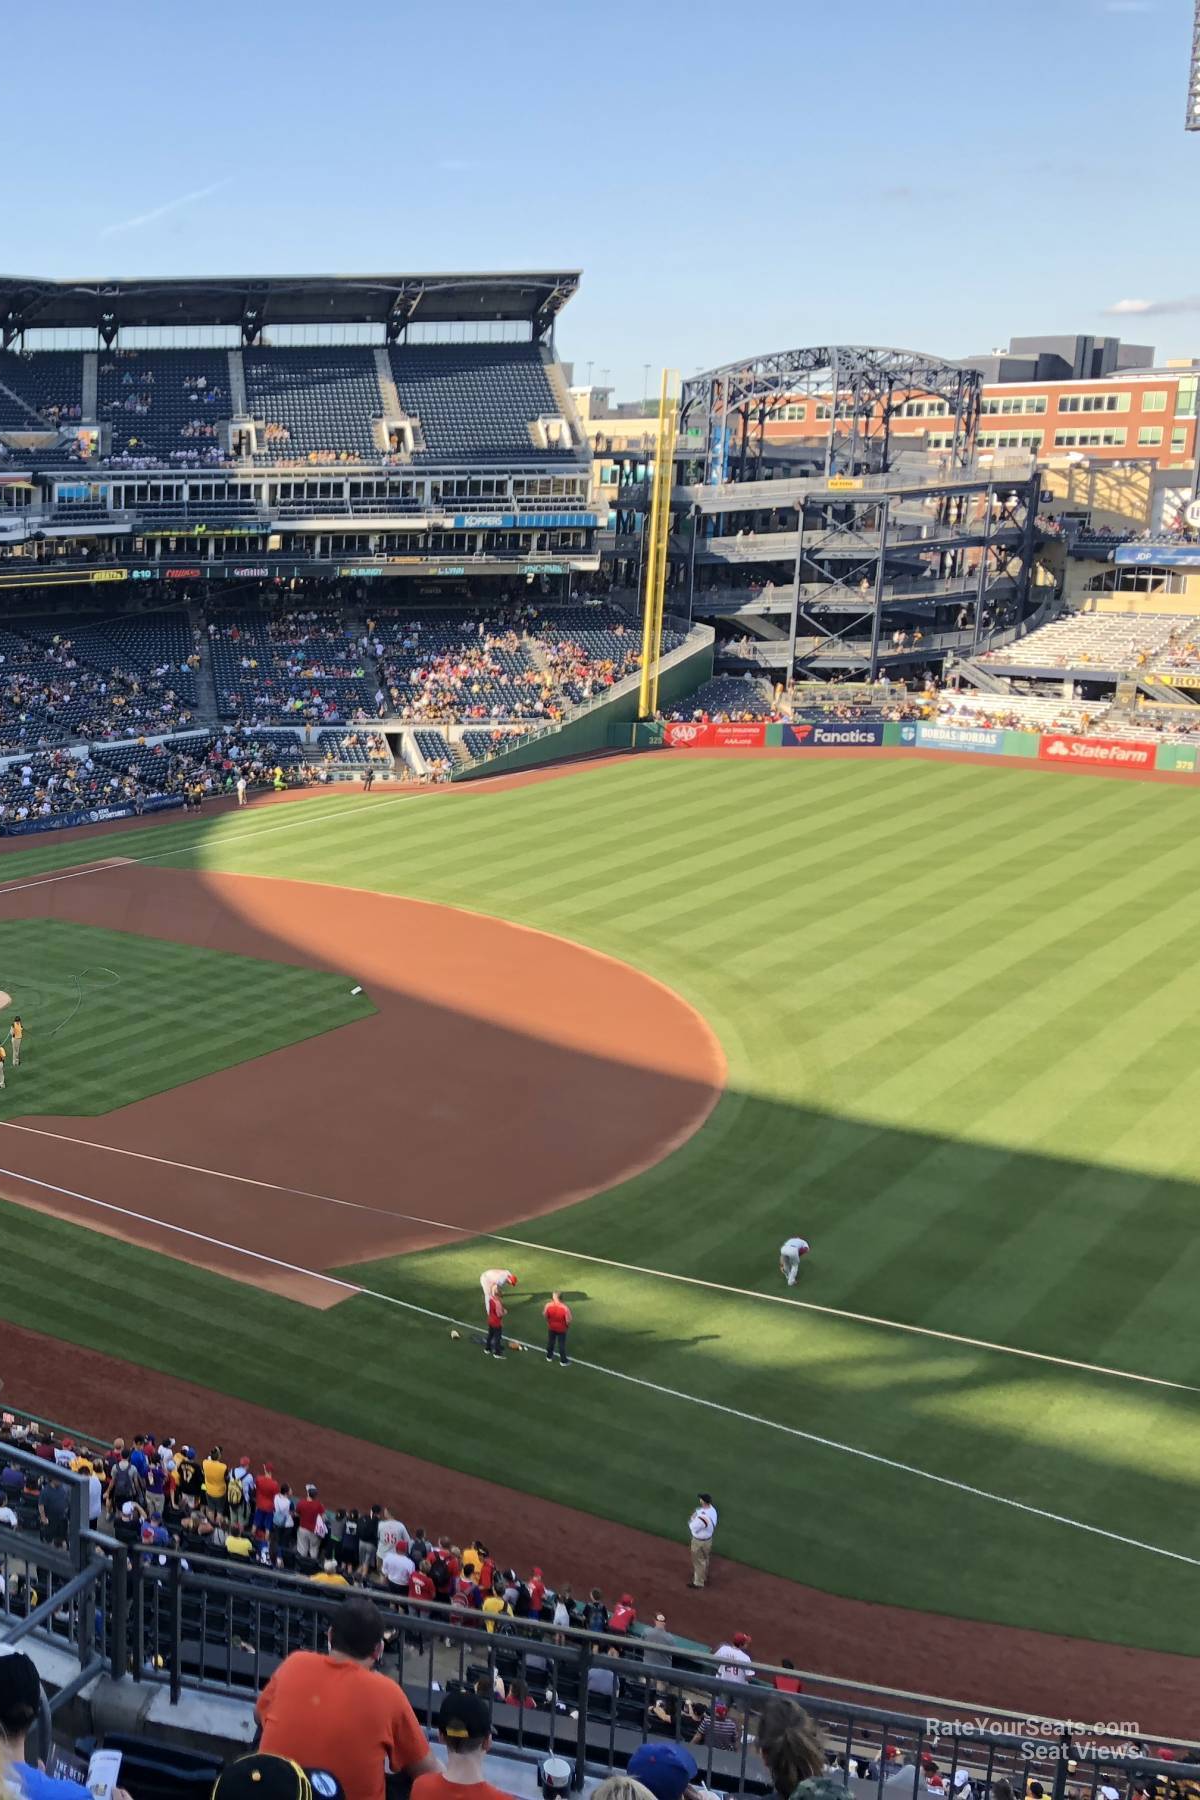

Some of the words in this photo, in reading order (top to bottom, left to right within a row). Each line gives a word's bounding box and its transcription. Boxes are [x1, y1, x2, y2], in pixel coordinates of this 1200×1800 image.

[464, 515, 503, 527] KOPPERS
[672, 726, 696, 740] AAA
[814, 728, 876, 743] Fanatics
[921, 727, 957, 741] BORDAS
[960, 731, 998, 745] BORDAS
